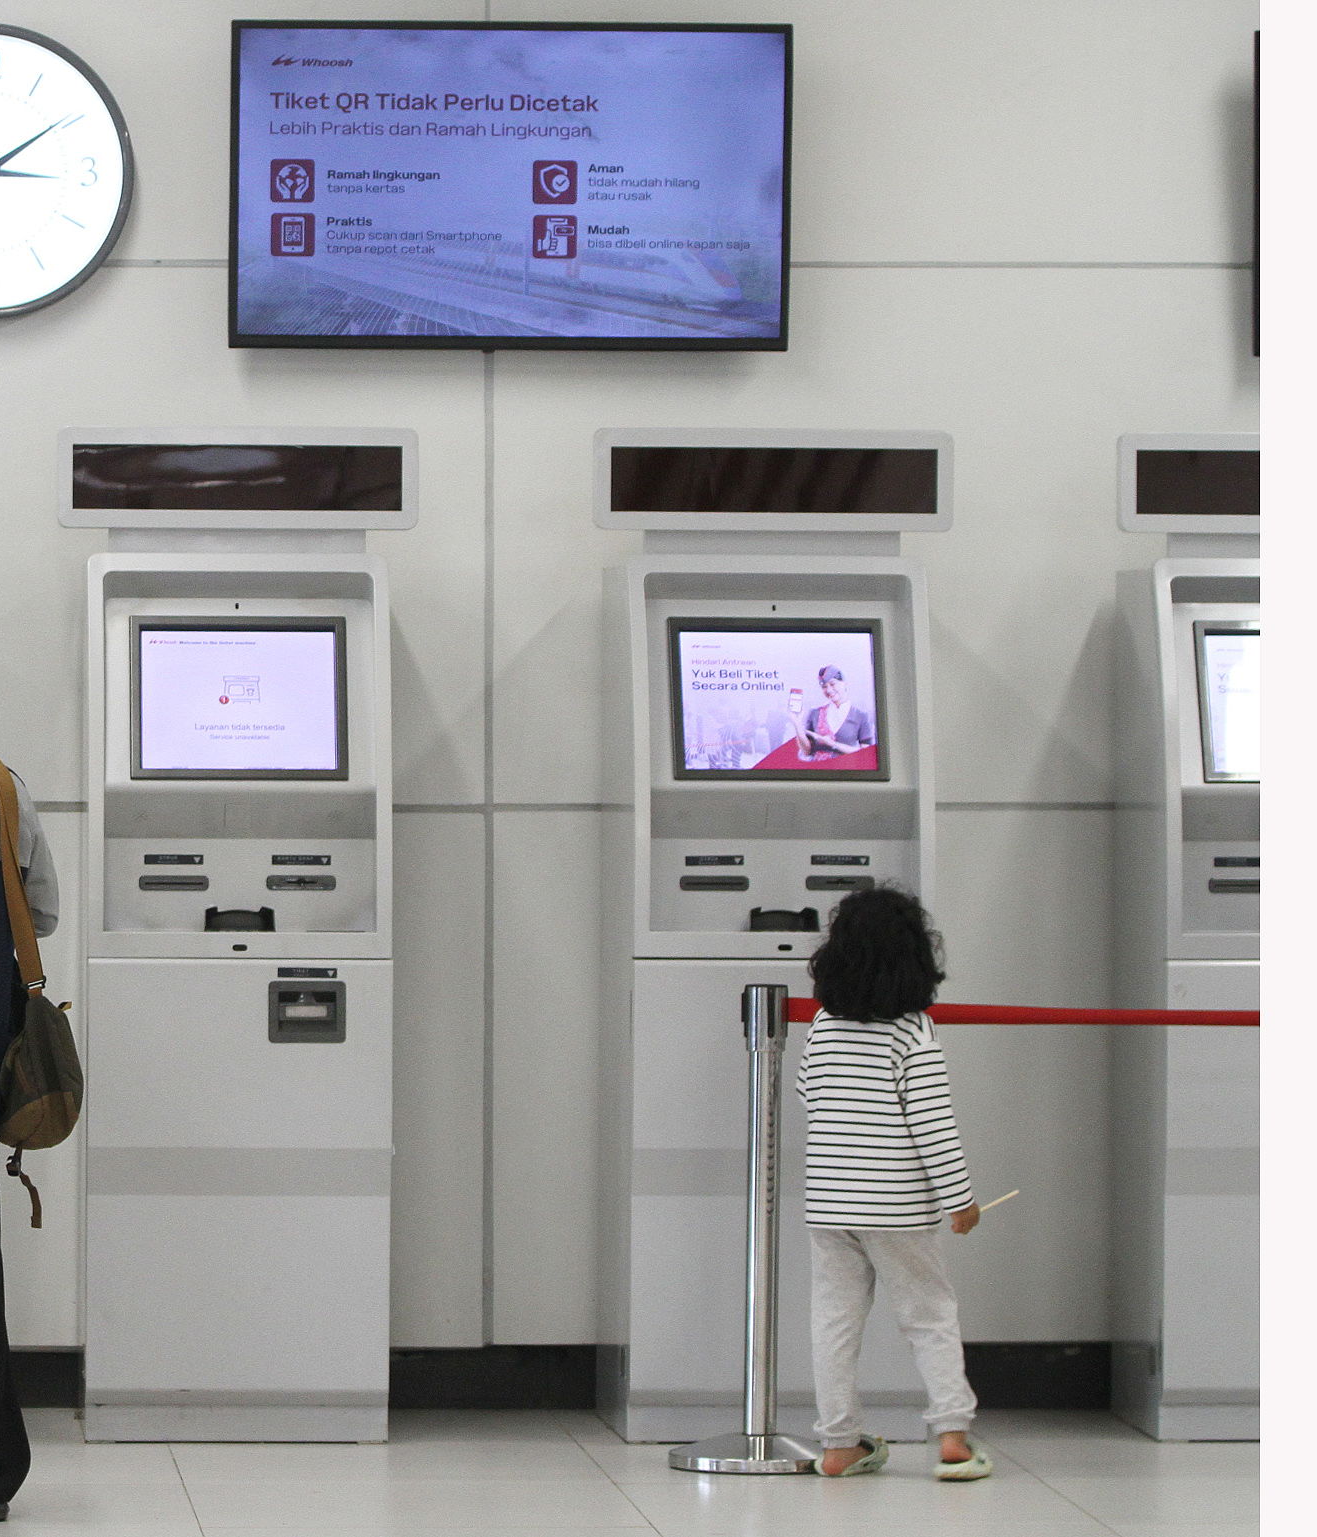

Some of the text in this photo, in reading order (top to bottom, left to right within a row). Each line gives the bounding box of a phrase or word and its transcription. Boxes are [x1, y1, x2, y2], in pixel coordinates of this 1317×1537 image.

[302, 58, 353, 67] Whoosh
[271, 92, 598, 113] Tiket QR Tidak Perlu Dicetak
[270, 121, 592, 140] Lebih Praktis dan Ramah Lingkungan
[81, 157, 98, 186] 3
[589, 164, 624, 173] Aman
[328, 170, 440, 181] Ramah lingkungan
[589, 177, 700, 189] tidak mudah hilang
[328, 184, 405, 194] tanpa kertas
[589, 191, 651, 200] atau rusak
[327, 216, 372, 226] Praktis
[588, 225, 629, 234] Mudah
[327, 231, 502, 242] Cukup scan dari Smartphone
[327, 244, 435, 255] tanpa repot cetak
[588, 239, 750, 251] bisa dibeli online kapan saja
[692, 670, 779, 678] Yuk Beli Tiket
[692, 681, 784, 690] Secara Online!
